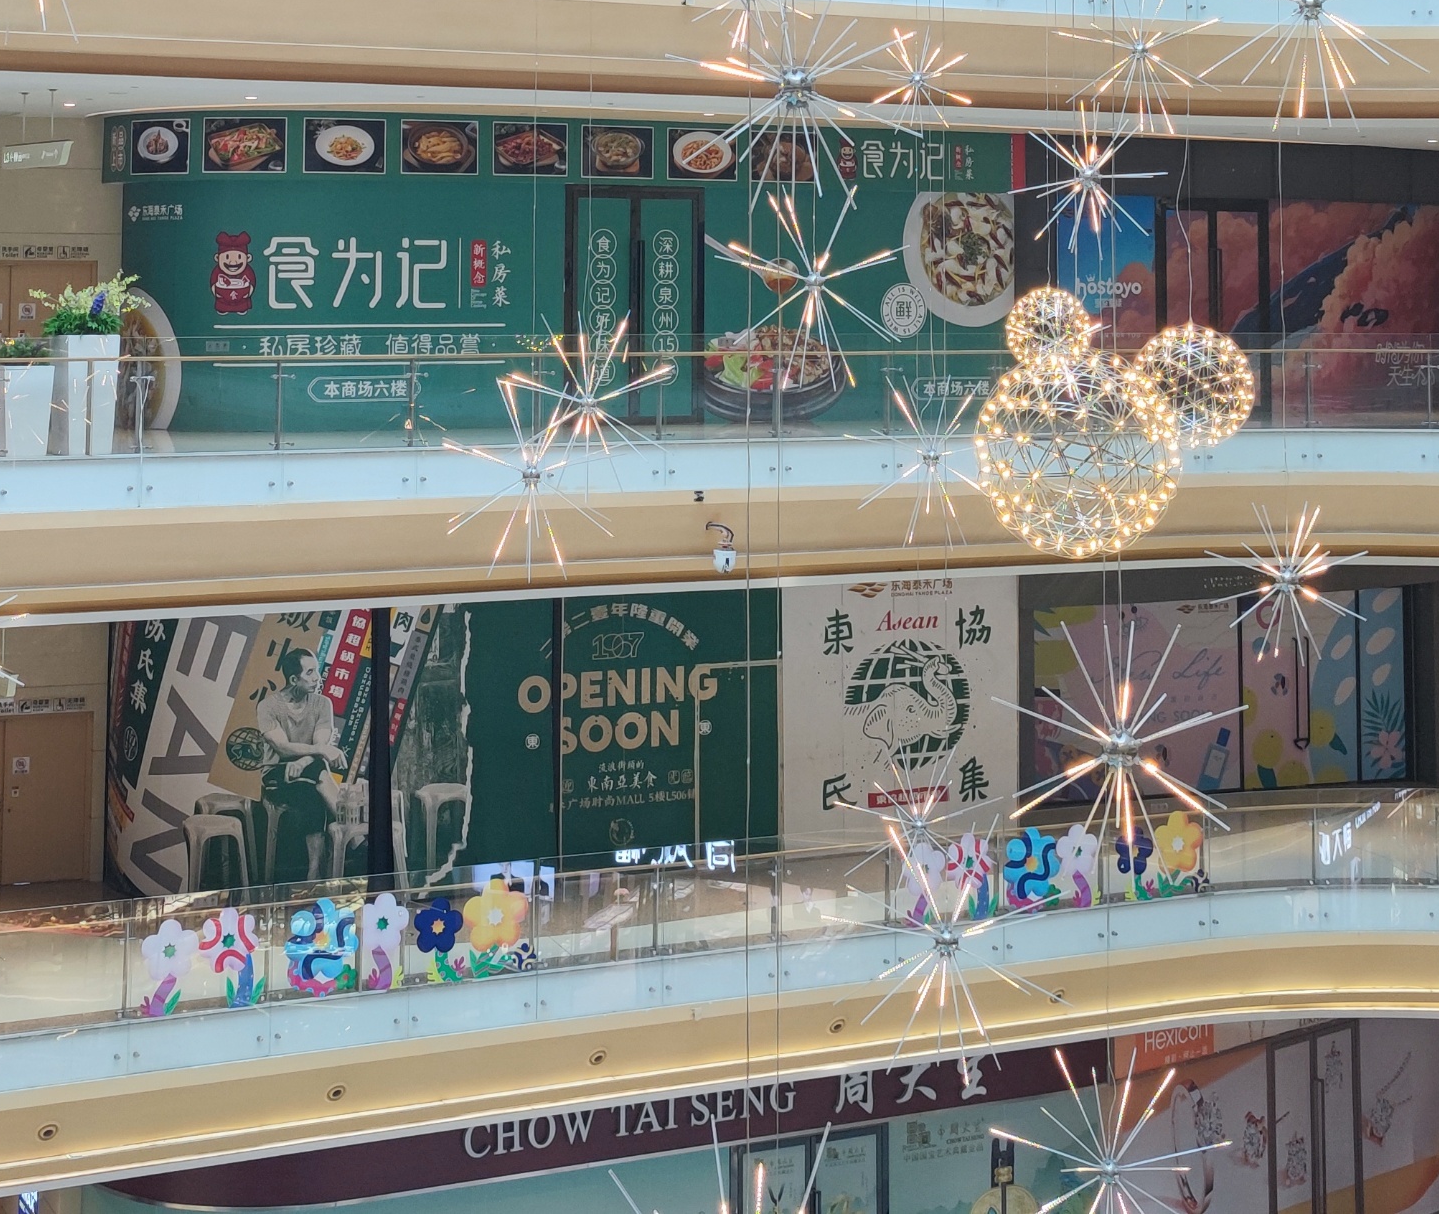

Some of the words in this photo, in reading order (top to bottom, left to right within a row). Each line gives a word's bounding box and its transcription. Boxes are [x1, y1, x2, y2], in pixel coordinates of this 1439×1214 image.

[861, 140, 944, 180] 食为记
[264, 236, 449, 309] 食为记
[472, 243, 486, 284] 新概念
[491, 240, 512, 307] 私房菜
[1076, 277, 1142, 298] hostoyo
[895, 300, 913, 319] 鮮
[259, 332, 362, 356] 私房珍藏
[324, 381, 407, 398] 本商场六楼
[393, 612, 414, 632] 肉
[823, 608, 854, 656] 東
[955, 605, 992, 649] 協
[876, 610, 939, 632] Asean
[518, 665, 718, 714] OPENING
[526, 735, 540, 749] 東
[561, 710, 679, 755] SOON
[588, 771, 657, 793] 東南亞美食
[823, 773, 857, 811] 氏
[959, 756, 989, 802] 集
[464, 1111, 595, 1159] CHOW
[610, 1099, 679, 1138] TAI
[689, 1082, 796, 1127] SENG
